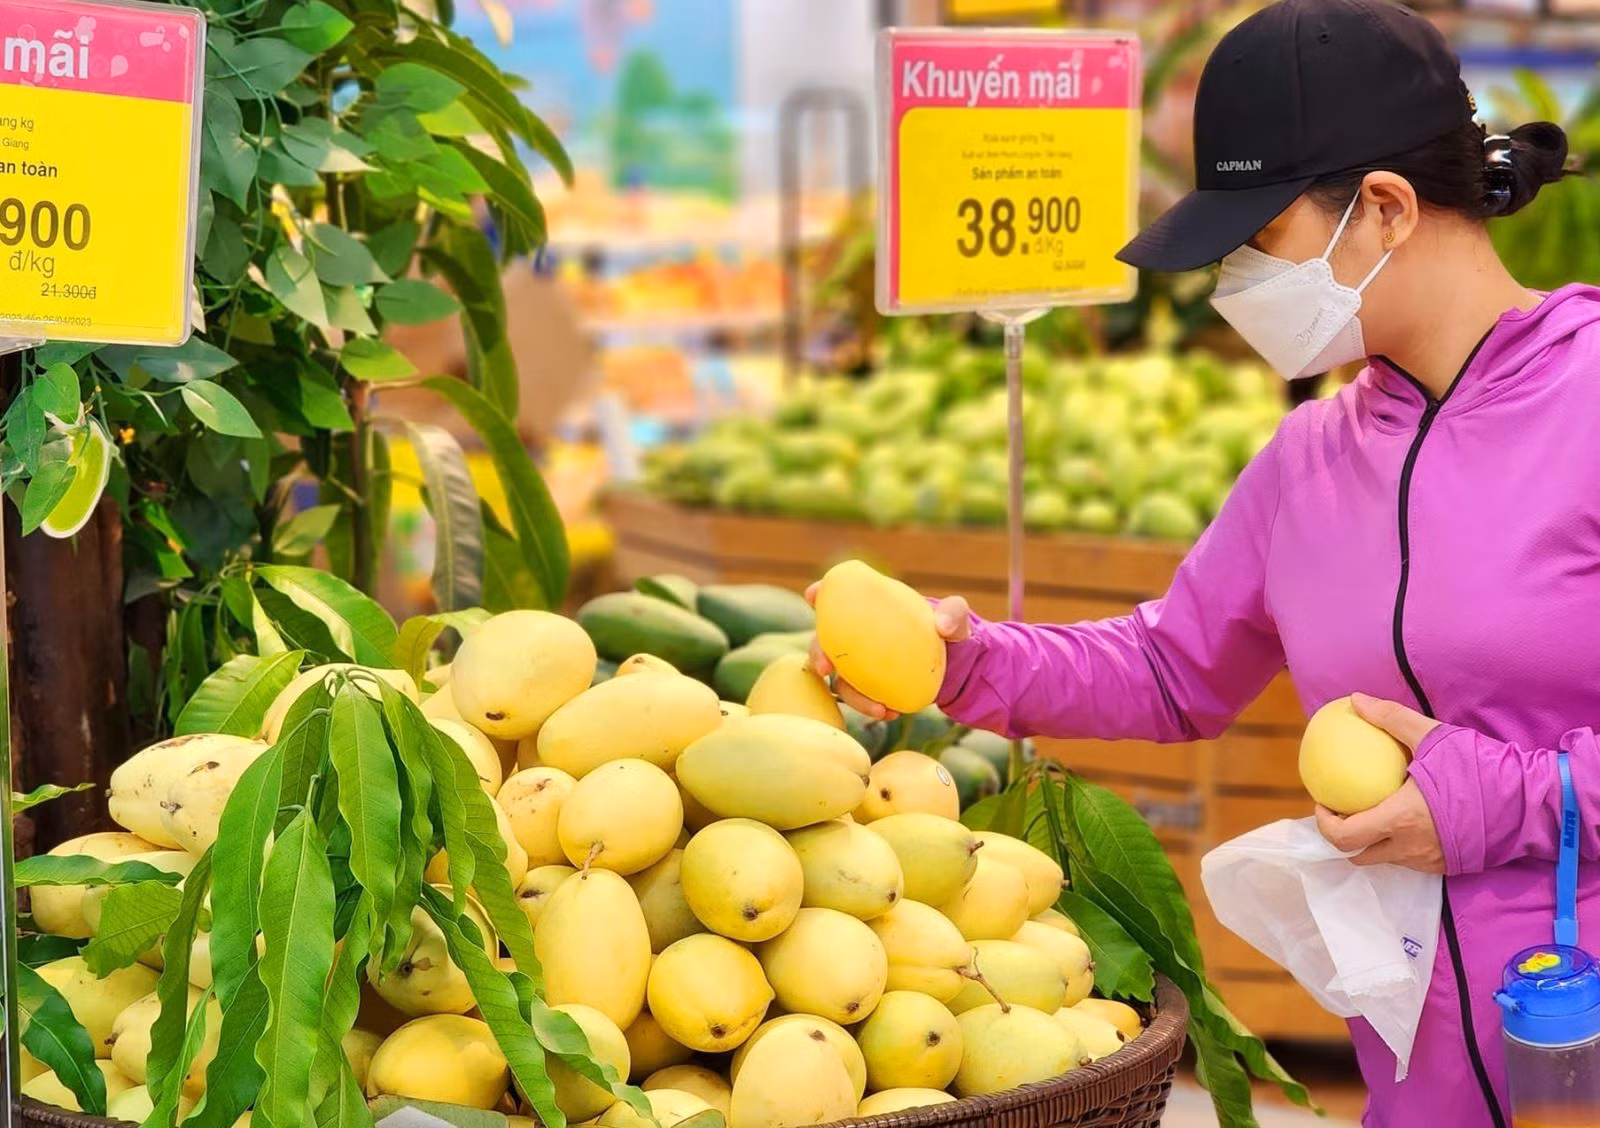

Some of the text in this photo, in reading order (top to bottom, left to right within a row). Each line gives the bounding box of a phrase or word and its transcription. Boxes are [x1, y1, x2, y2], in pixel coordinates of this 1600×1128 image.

[4, 28, 90, 80] mãi
[902, 54, 1081, 107] Khuyến mãi
[20, 116, 34, 132] kg
[2, 137, 30, 151] Giang
[22, 160, 58, 178] toàn
[1216, 159, 1262, 171] CAPMAN
[0, 197, 91, 251] 900
[9, 249, 55, 279] đ/kg
[41, 282, 97, 300] 21.300đ
